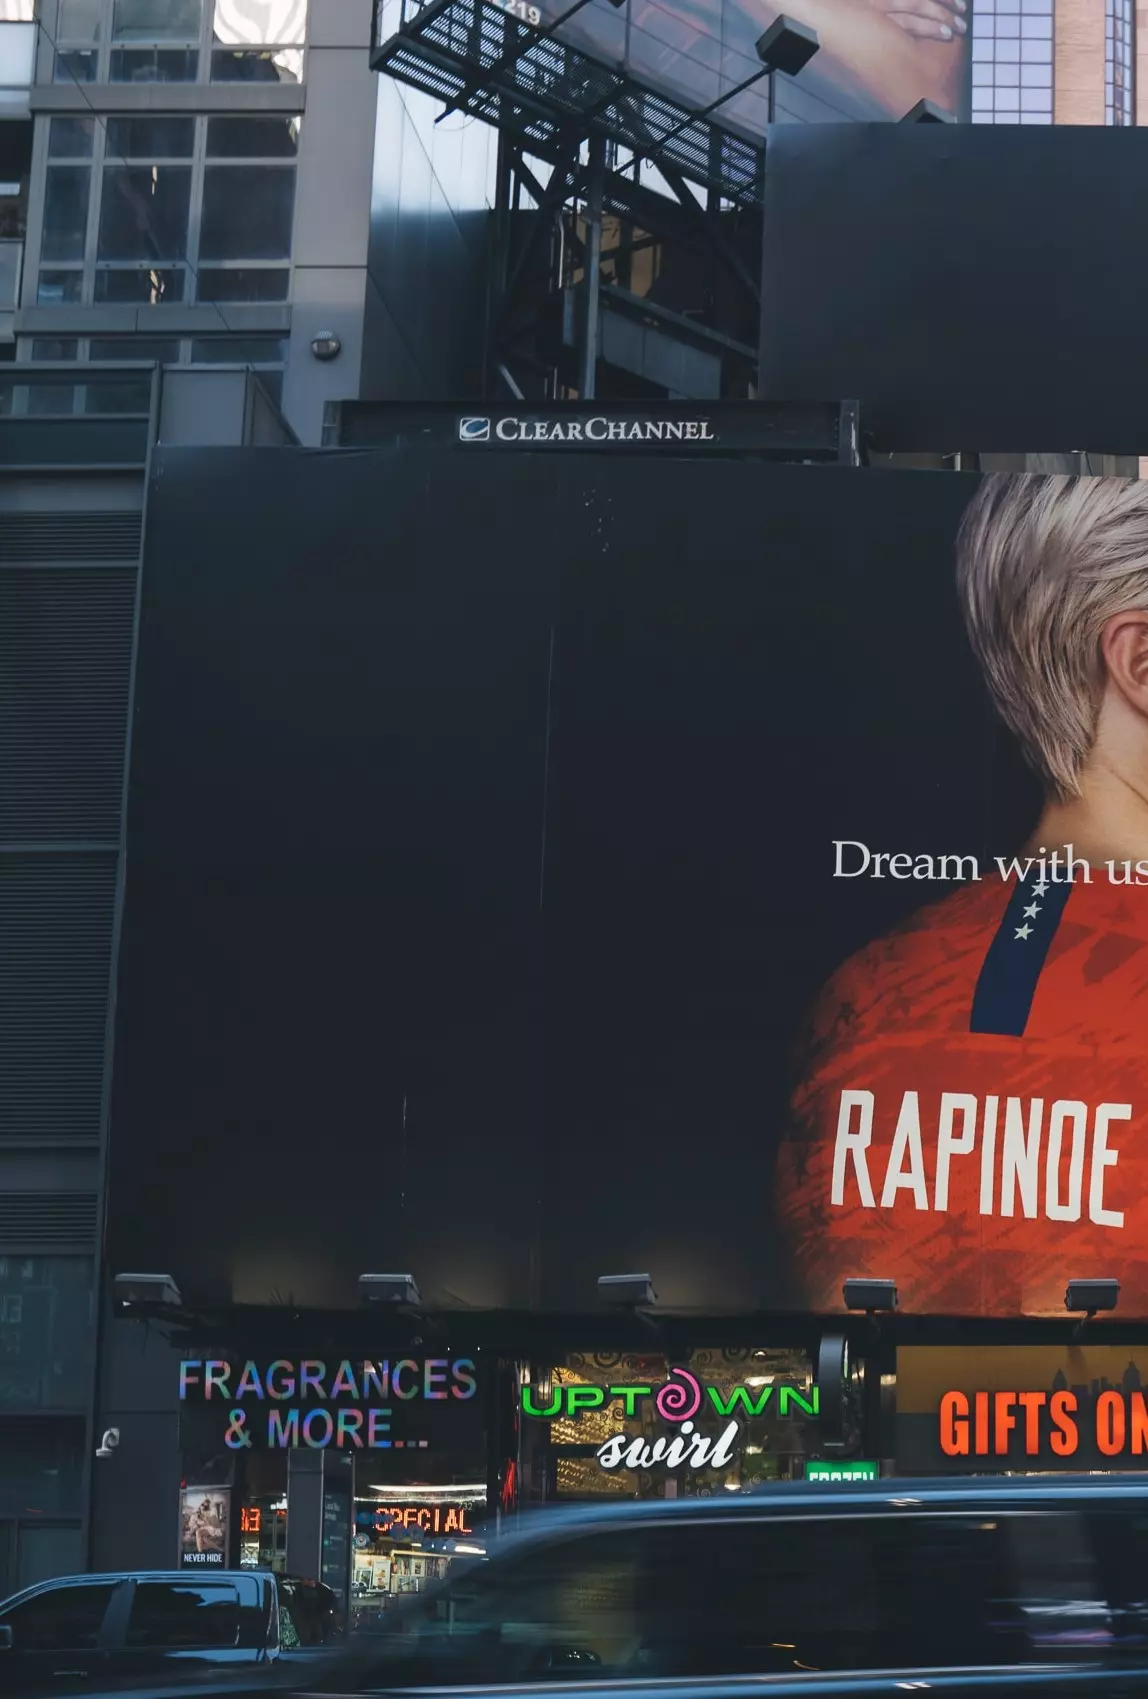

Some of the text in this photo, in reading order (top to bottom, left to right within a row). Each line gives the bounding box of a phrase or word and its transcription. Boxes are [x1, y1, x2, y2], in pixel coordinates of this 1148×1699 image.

[832, 840, 982, 881] Dream
[994, 843, 1093, 884] with
[830, 1089, 1132, 1228] RAPINOE
[179, 1359, 477, 1400] FRAGRANCES
[224, 1408, 428, 1449] & MORE...
[597, 1420, 739, 1468] swirl
[940, 1390, 1078, 1456] GIFTS
[375, 1508, 472, 1532] SPECIAL
[183, 1553, 223, 1563] NEVER HIDE
